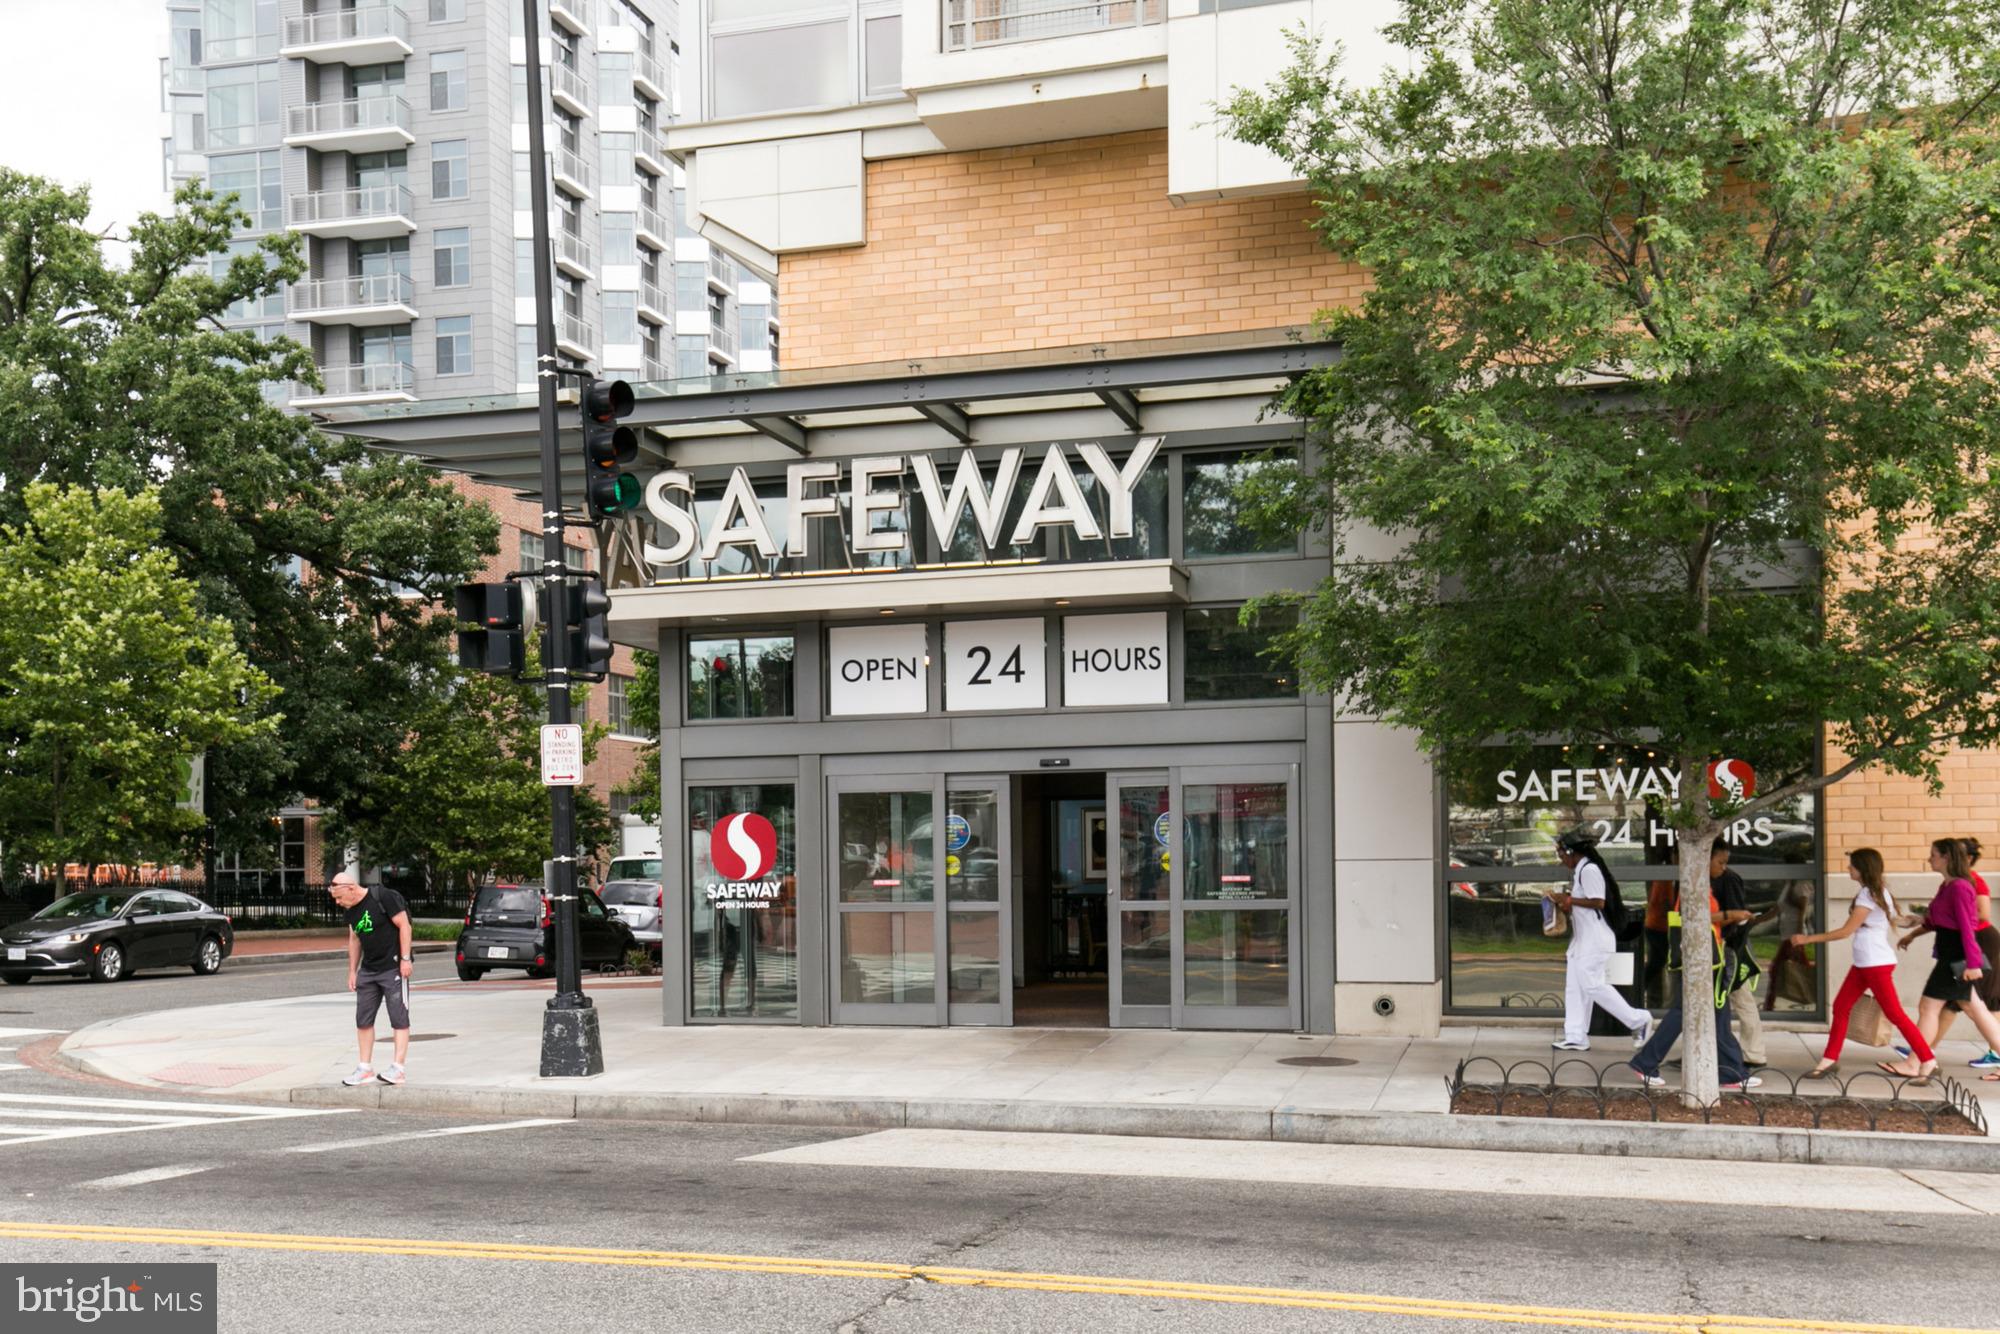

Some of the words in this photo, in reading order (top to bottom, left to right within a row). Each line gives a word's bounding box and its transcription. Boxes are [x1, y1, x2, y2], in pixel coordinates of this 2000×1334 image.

[644, 435, 1166, 566] SAFEWAY
[841, 657, 917, 683] OPEN
[966, 643, 1026, 686] 24
[1071, 646, 1162, 673] HOURS
[554, 728, 568, 740] NO
[1496, 766, 1683, 803] SAFEWAY
[1592, 820, 1632, 847] 24
[1650, 817, 1774, 848] HRS
[707, 882, 781, 899] SAFEWAY
[745, 901, 770, 909] HOURS
